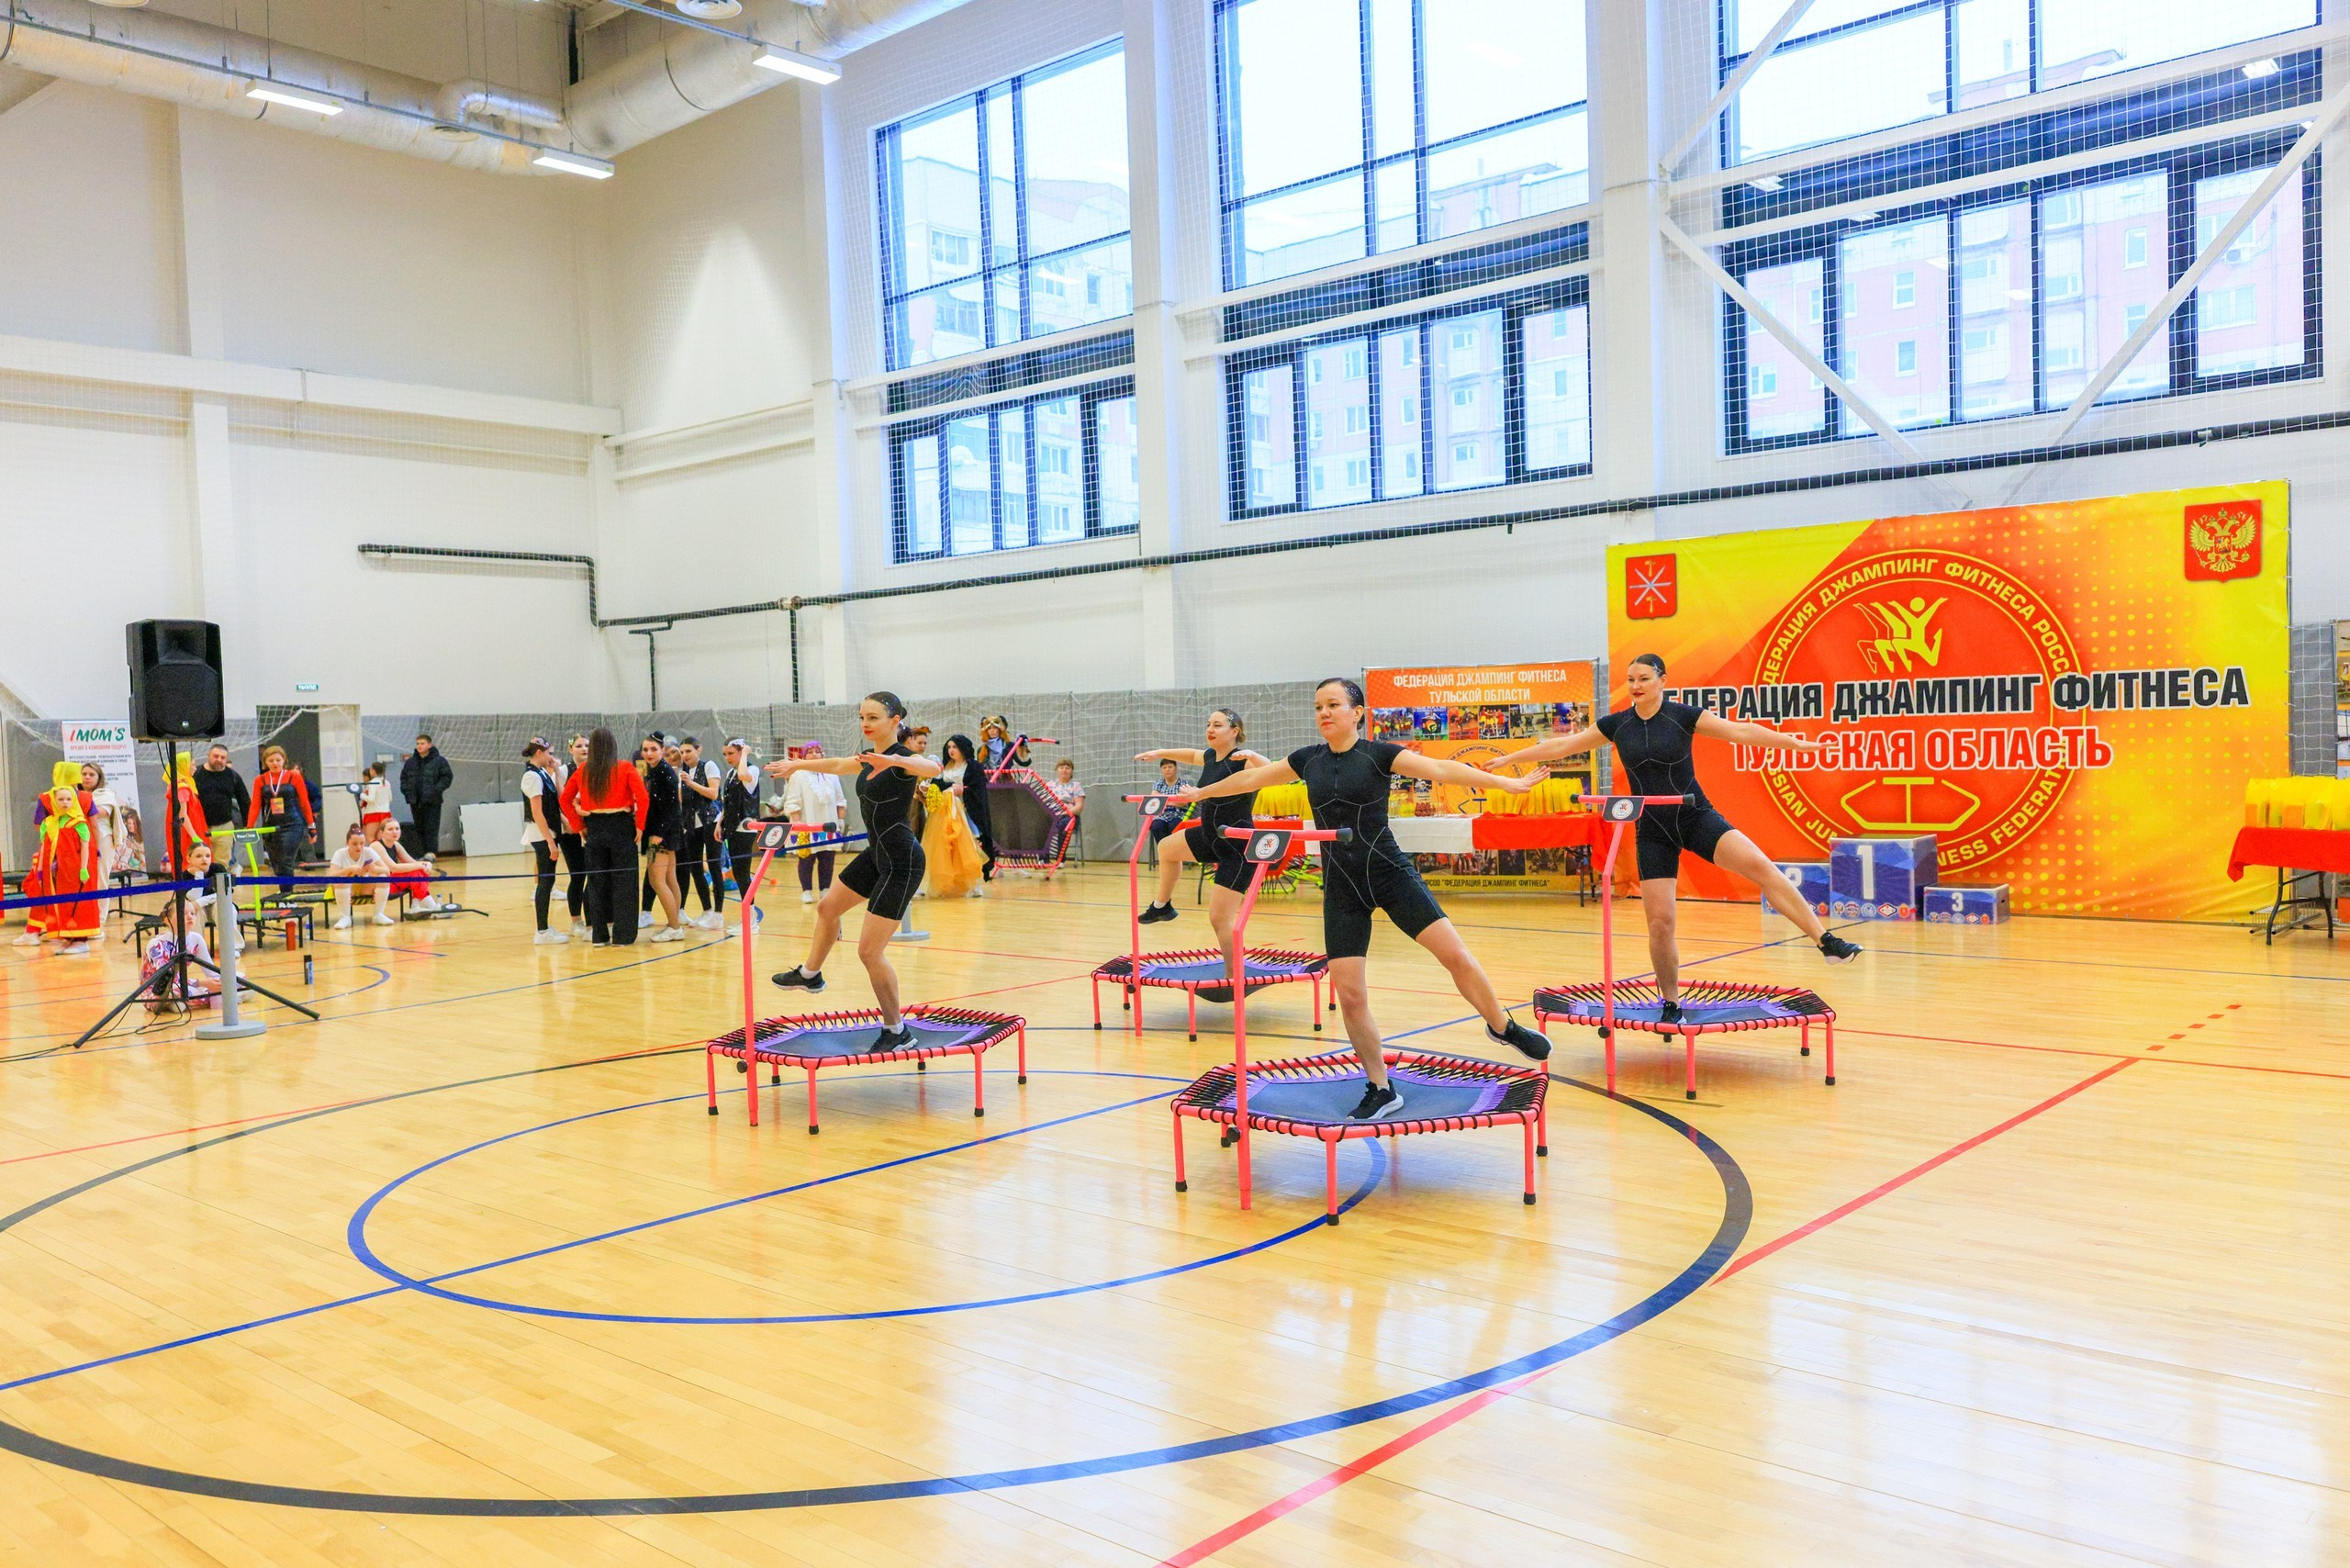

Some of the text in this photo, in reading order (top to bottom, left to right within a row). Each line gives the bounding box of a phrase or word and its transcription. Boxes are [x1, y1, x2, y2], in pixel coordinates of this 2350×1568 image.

[1762, 558, 2071, 686] ДЕРАЦИЯ ДЖАМПИНГ ФИТНЕСА РОСС
[1393, 669, 1566, 689] ФЕДЕРАЦИЯ ДЖАМПИНГ ФИТНЕСА
[1428, 689, 1530, 703] ТУЛЬСКОЙ ОБЛАСТИ
[1832, 675, 2042, 724] ДЖАМПИНГ
[2052, 666, 2251, 711] ФИТНЕСА
[1925, 725, 2113, 772] ОБЛАСТЬ
[1938, 839, 1988, 868] NESS
[1482, 879, 1516, 888] ДЖАМПИНГ
[1856, 845, 1874, 900] 1
[1952, 891, 1964, 913] 3
